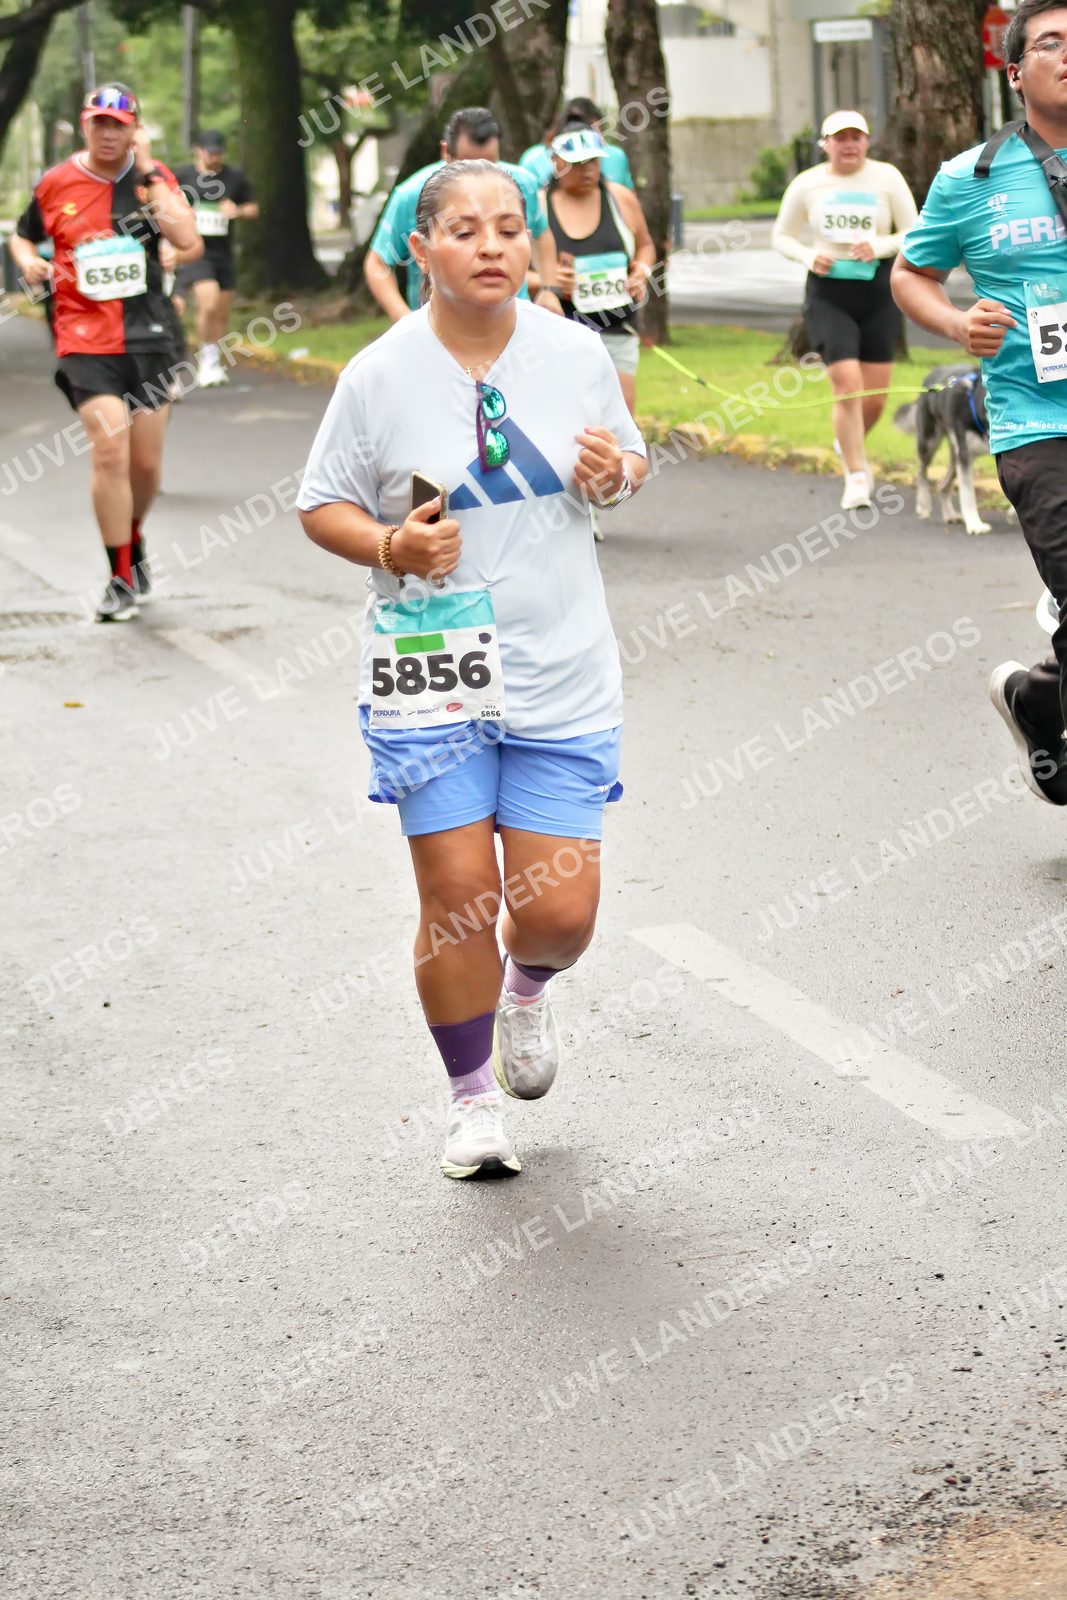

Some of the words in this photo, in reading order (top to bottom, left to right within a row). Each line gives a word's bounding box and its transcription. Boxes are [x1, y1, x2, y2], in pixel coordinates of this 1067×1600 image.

[824, 214, 872, 230] 3096
[85, 263, 142, 285] 6368
[1039, 323, 1067, 356] 5
[372, 650, 492, 697] 5856
[372, 709, 401, 717] PERDURA
[480, 710, 501, 718] 5856
